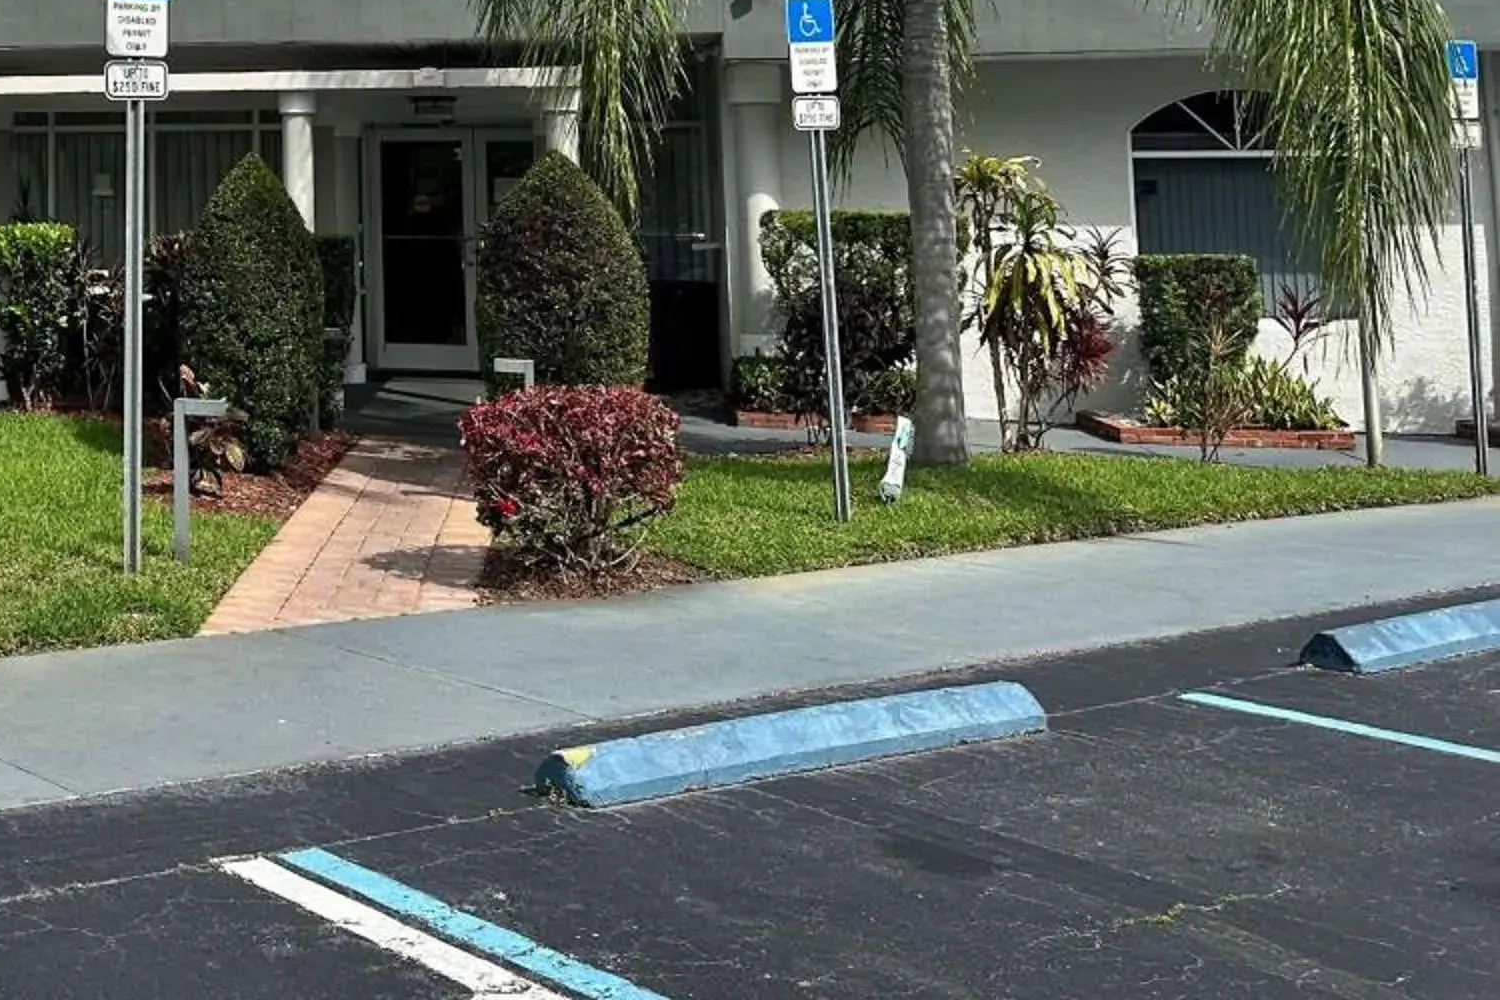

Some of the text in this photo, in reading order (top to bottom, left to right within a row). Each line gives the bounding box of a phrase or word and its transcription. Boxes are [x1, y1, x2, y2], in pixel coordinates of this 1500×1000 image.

[114, 2, 148, 12] PARKING
[117, 15, 156, 25] DISABLED
[122, 29, 152, 38] PERMIT
[123, 67, 137, 79] UP
[112, 81, 161, 93] $250 FINE
